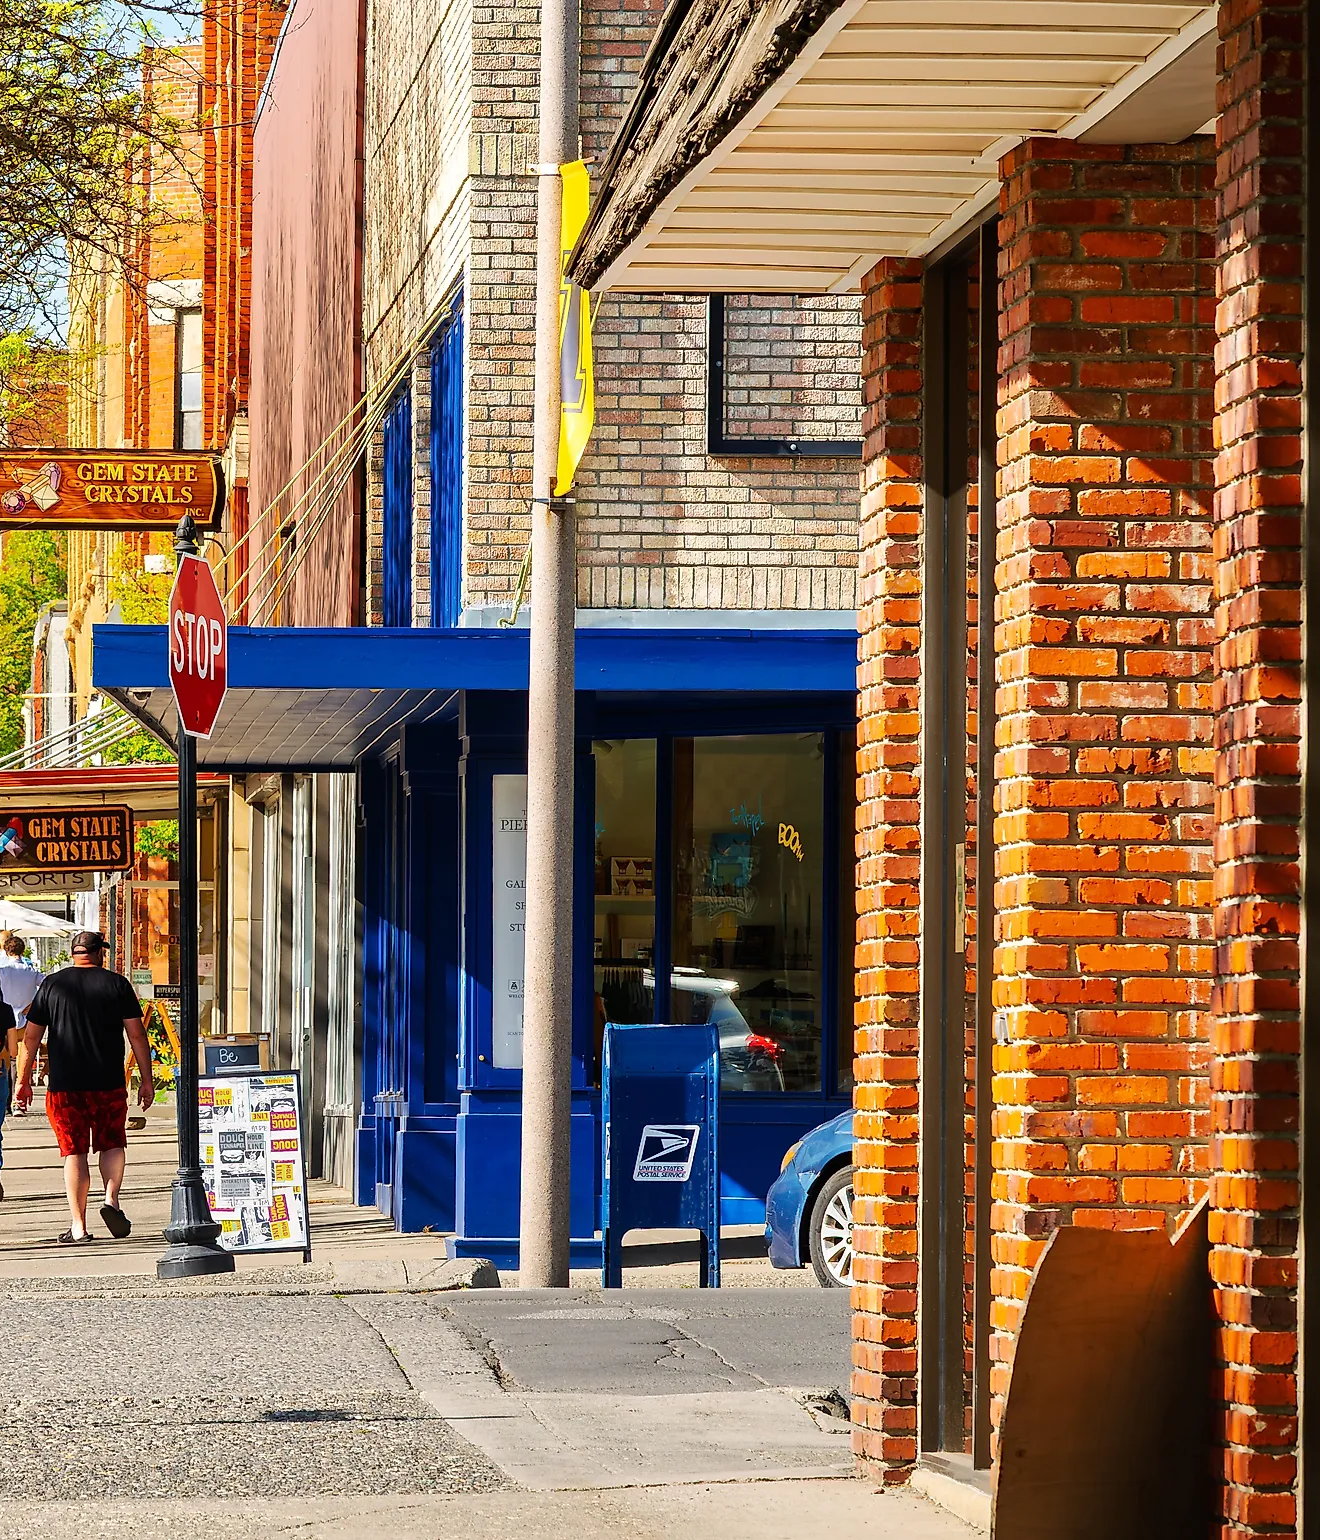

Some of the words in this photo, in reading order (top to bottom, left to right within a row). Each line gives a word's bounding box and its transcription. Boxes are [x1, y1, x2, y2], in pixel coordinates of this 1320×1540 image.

[76, 462, 125, 481] GEM
[131, 463, 198, 482] STATE
[84, 484, 193, 504] CRYSTALS
[185, 507, 205, 517] INC.
[173, 609, 223, 680] STOP
[28, 816, 65, 839] GEM
[71, 815, 121, 838] STATE
[36, 839, 122, 863] CRYSTALS
[219, 1048, 238, 1064] Be
[198, 1089, 212, 1099] UG
[271, 1118, 297, 1129] DOUG
[219, 1134, 245, 1144] DOUG
[247, 1142, 264, 1150] LINE
[273, 1140, 298, 1150] DOUG
[274, 1195, 288, 1220] DOUG
